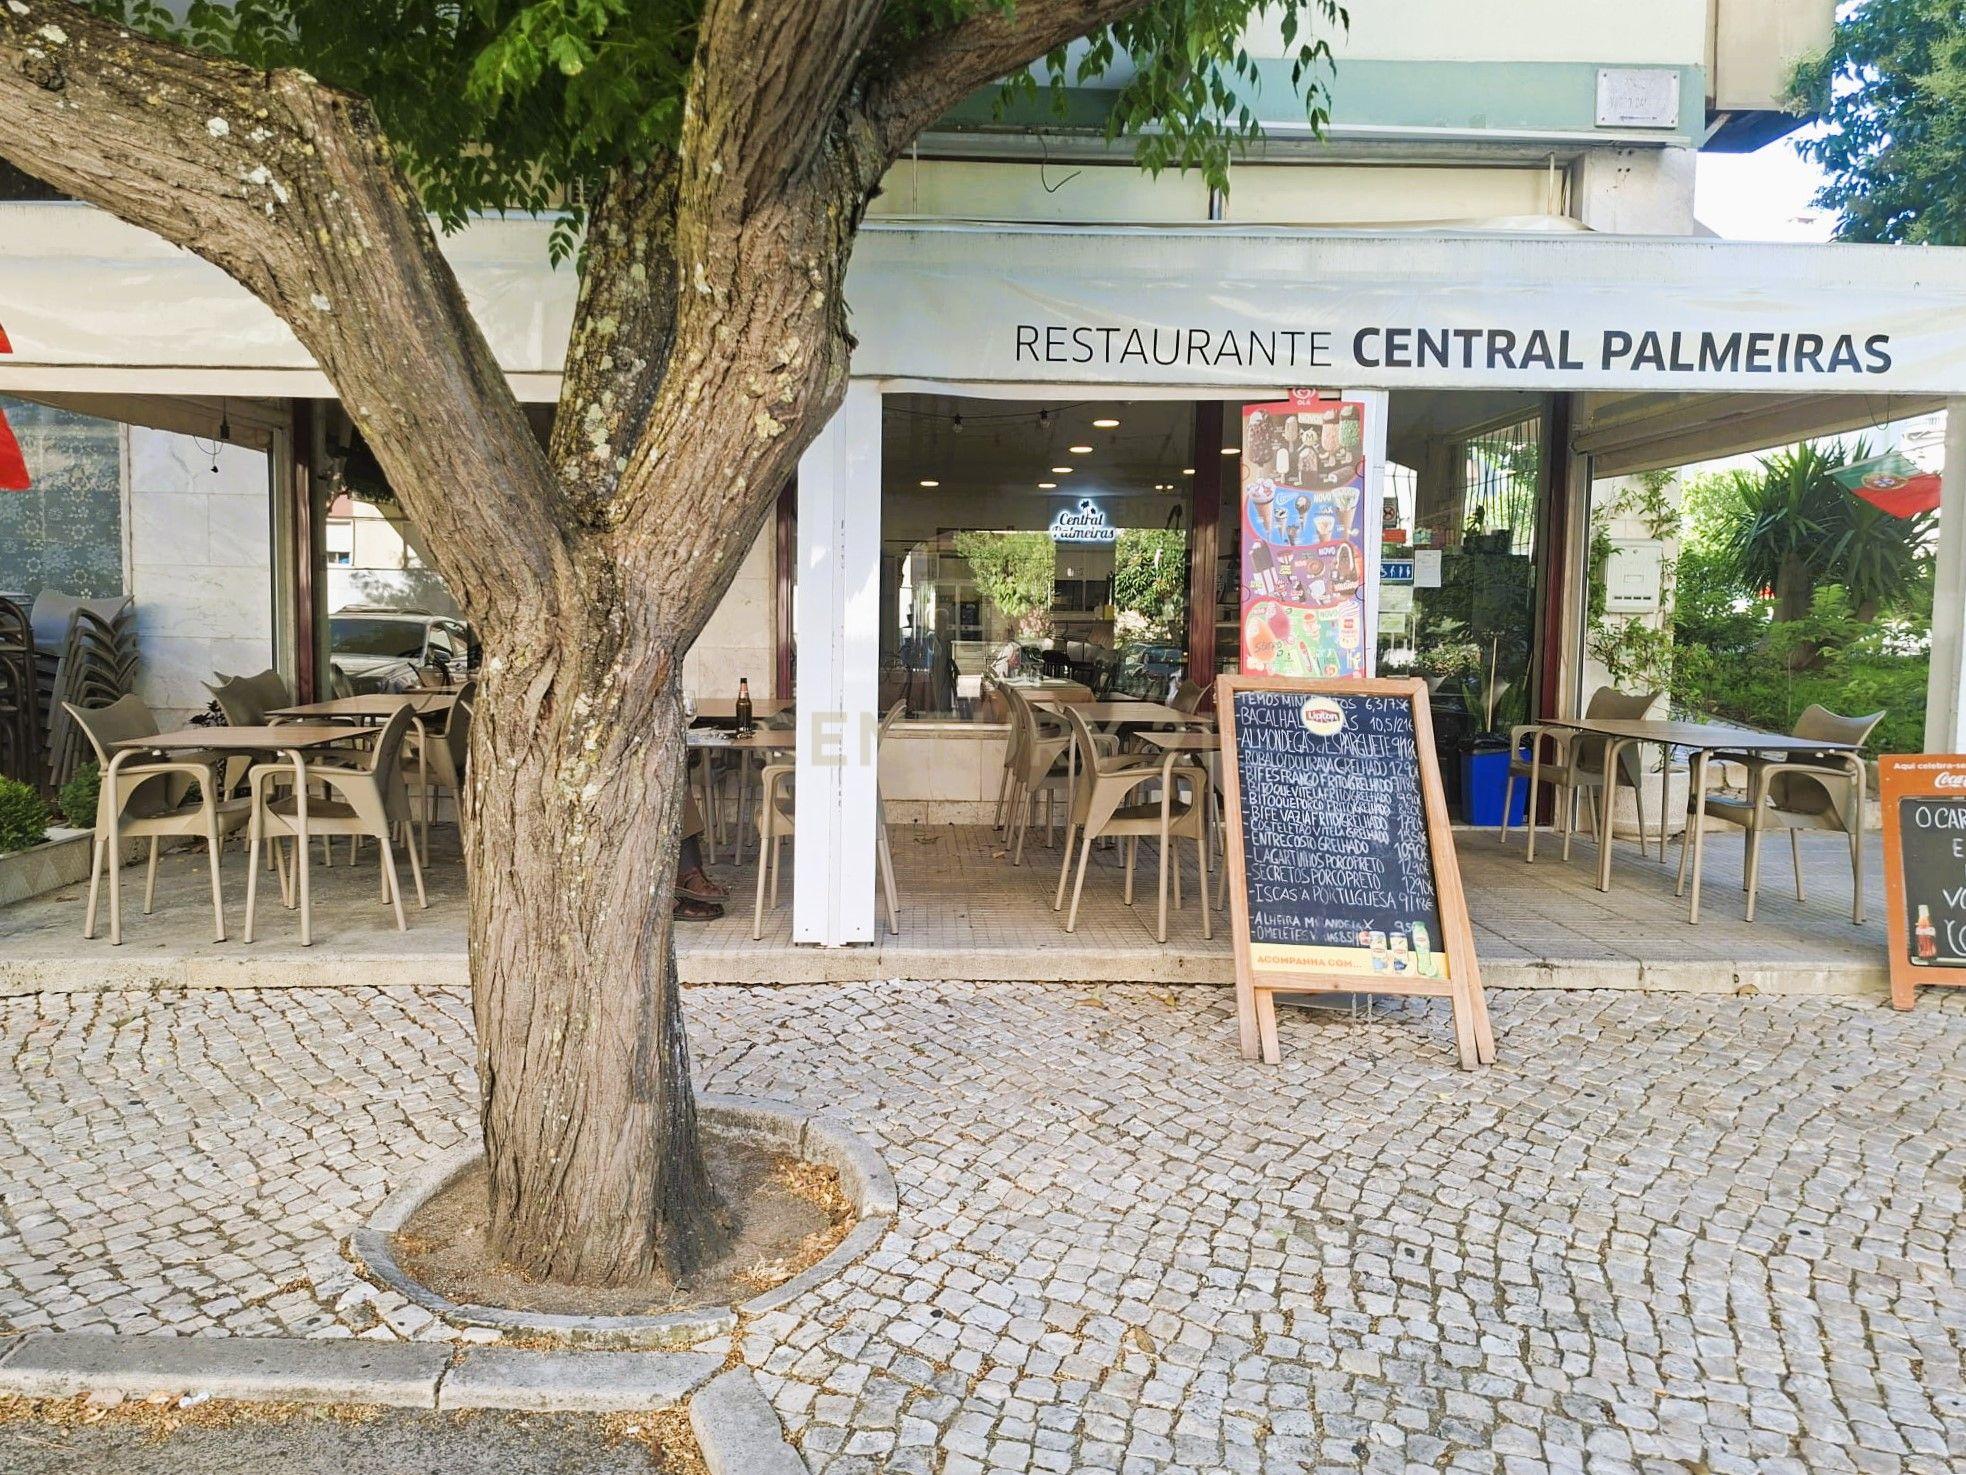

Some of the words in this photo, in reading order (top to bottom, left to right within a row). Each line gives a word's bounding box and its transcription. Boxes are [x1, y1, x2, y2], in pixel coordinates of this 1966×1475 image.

[1015, 325, 1333, 367] RESTAURANTE
[1353, 327, 1584, 370] CENTRAL
[1601, 330, 1892, 374] PALMEIRAS
[1059, 512, 1103, 526] Central
[1052, 525, 1114, 539] Palmeiras
[1893, 762, 1916, 770] Aqui
[1915, 806, 1932, 828] O
